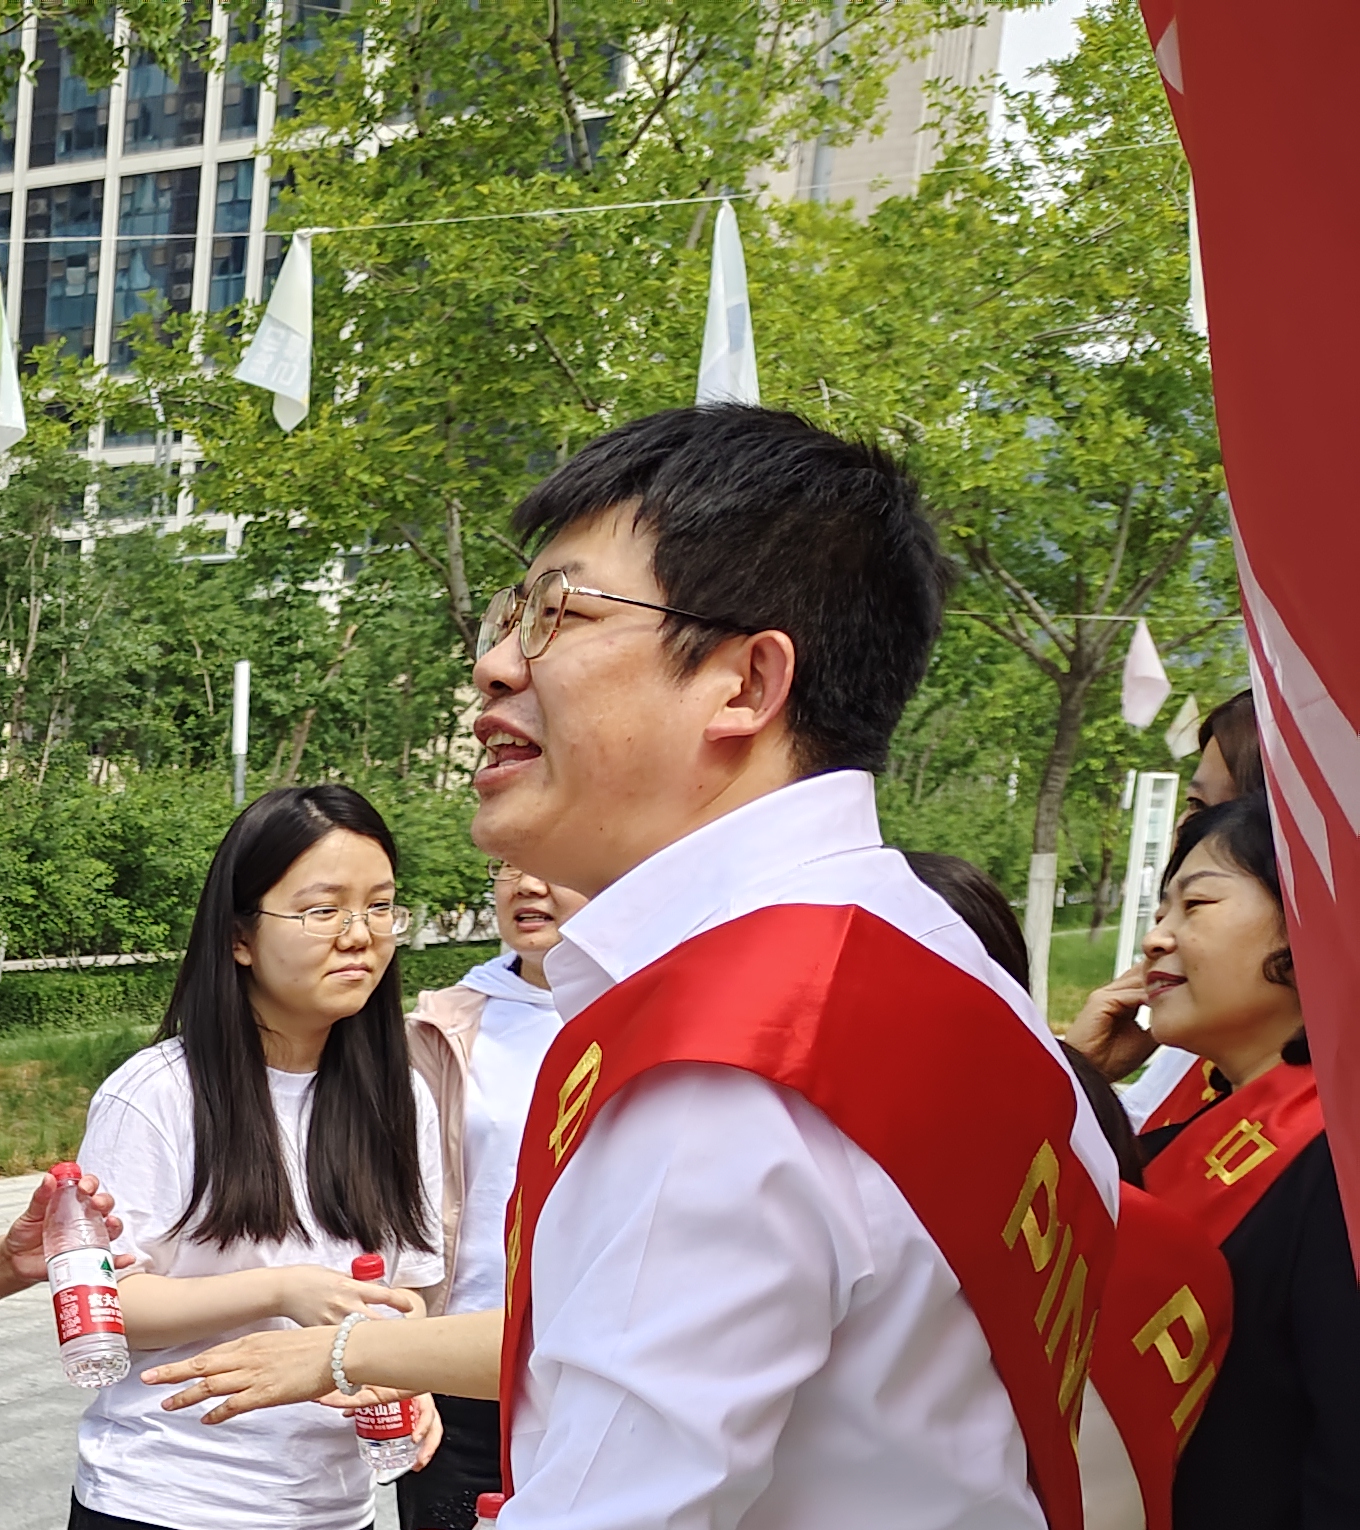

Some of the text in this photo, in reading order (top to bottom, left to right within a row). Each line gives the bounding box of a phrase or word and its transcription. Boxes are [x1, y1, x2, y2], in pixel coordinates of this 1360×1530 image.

[1203, 1118, 1278, 1186] 中
[1001, 1138, 1101, 1462] PIN
[1131, 1284, 1217, 1450] PI
